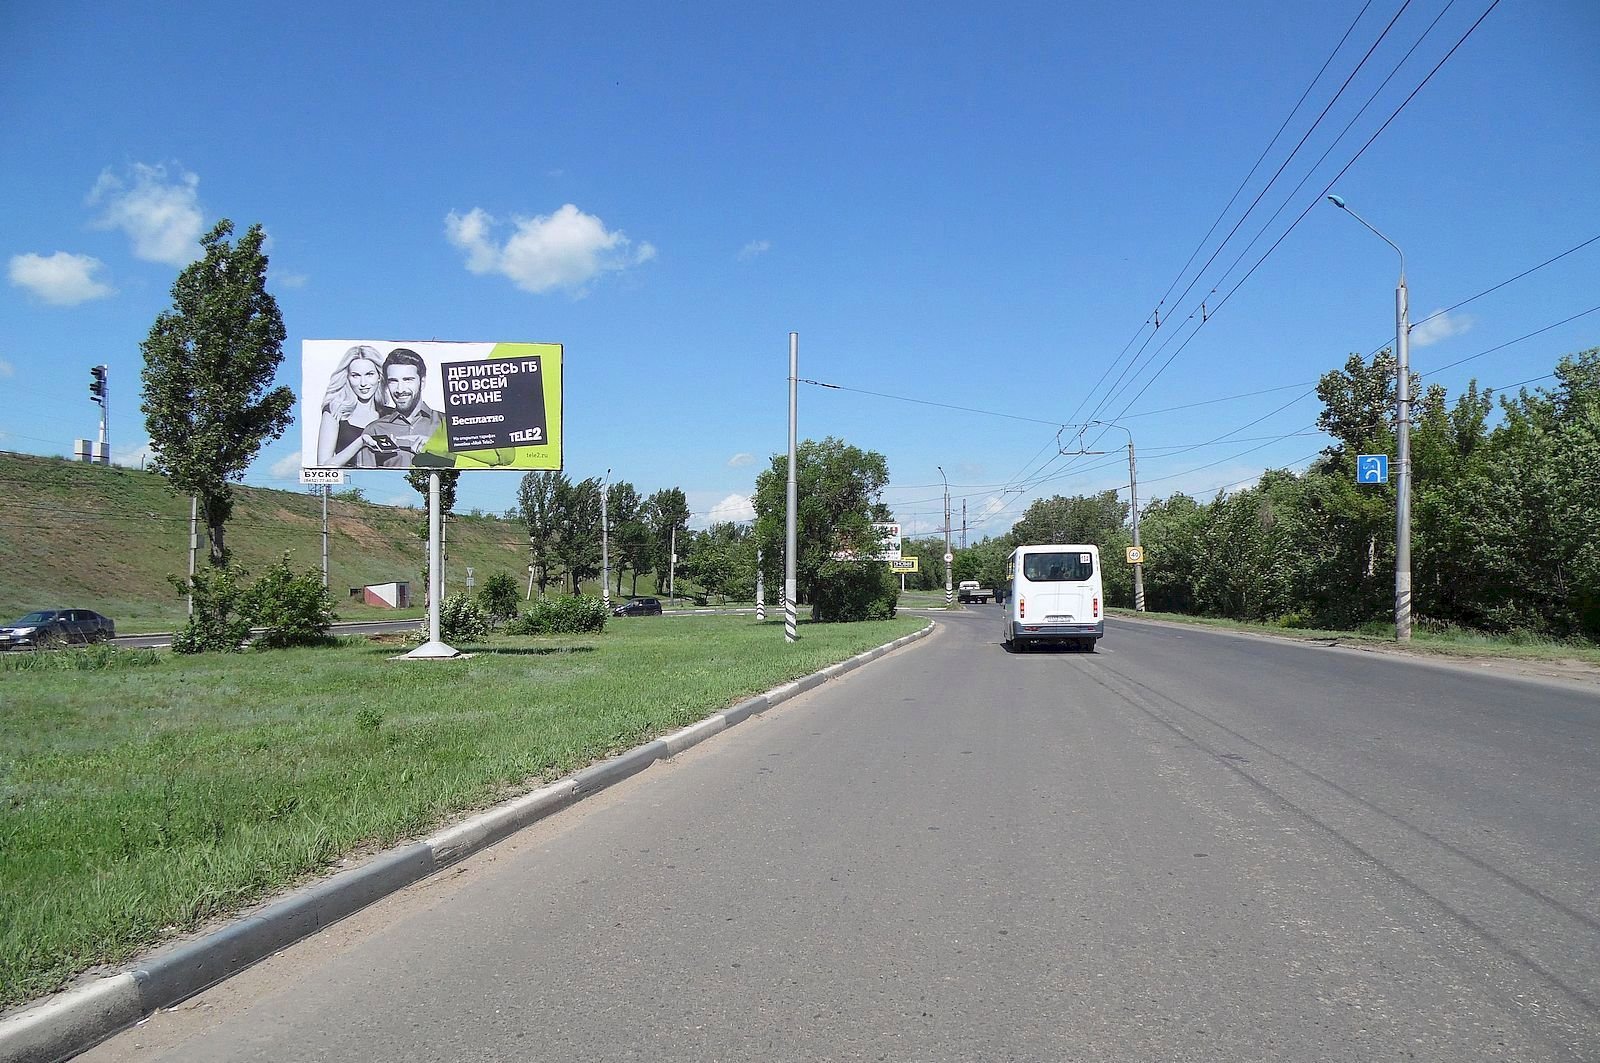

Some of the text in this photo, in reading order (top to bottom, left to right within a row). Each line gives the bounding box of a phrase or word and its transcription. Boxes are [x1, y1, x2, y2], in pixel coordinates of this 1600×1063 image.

[448, 361, 538, 380] ДЕЛИТЕСЬ ГБ
[449, 375, 508, 392] ПО ВСЕЙ
[450, 391, 502, 405] СТРАНЕ
[452, 415, 505, 426] Бесплатно
[509, 427, 543, 442] TELE2
